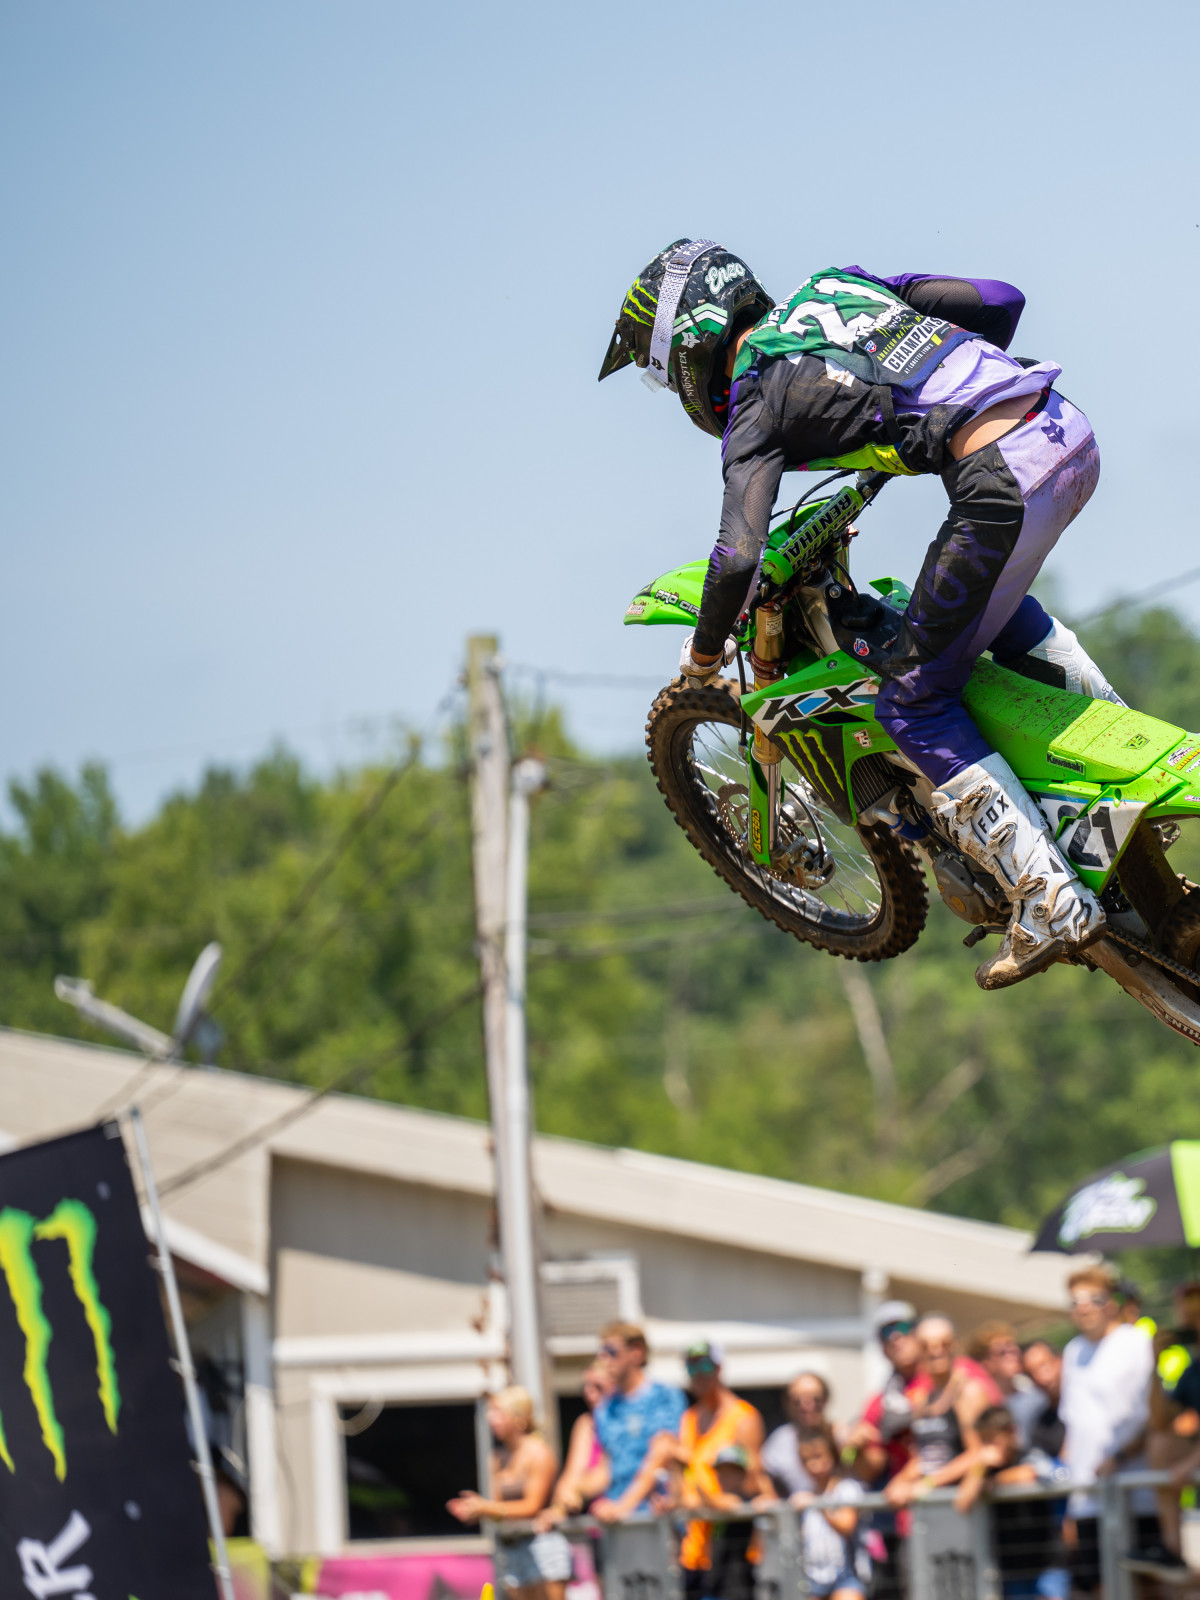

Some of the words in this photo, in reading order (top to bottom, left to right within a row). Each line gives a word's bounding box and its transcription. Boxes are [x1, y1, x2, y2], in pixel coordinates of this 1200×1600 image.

[683, 241, 705, 256] FOX
[705, 262, 745, 294] Enzo
[679, 351, 695, 397] MONSTER
[655, 589, 679, 605] PRO
[762, 678, 870, 721] KX
[1046, 752, 1085, 774] Kawasaki
[977, 794, 1010, 835] FOX
[1057, 804, 1119, 868] 21
